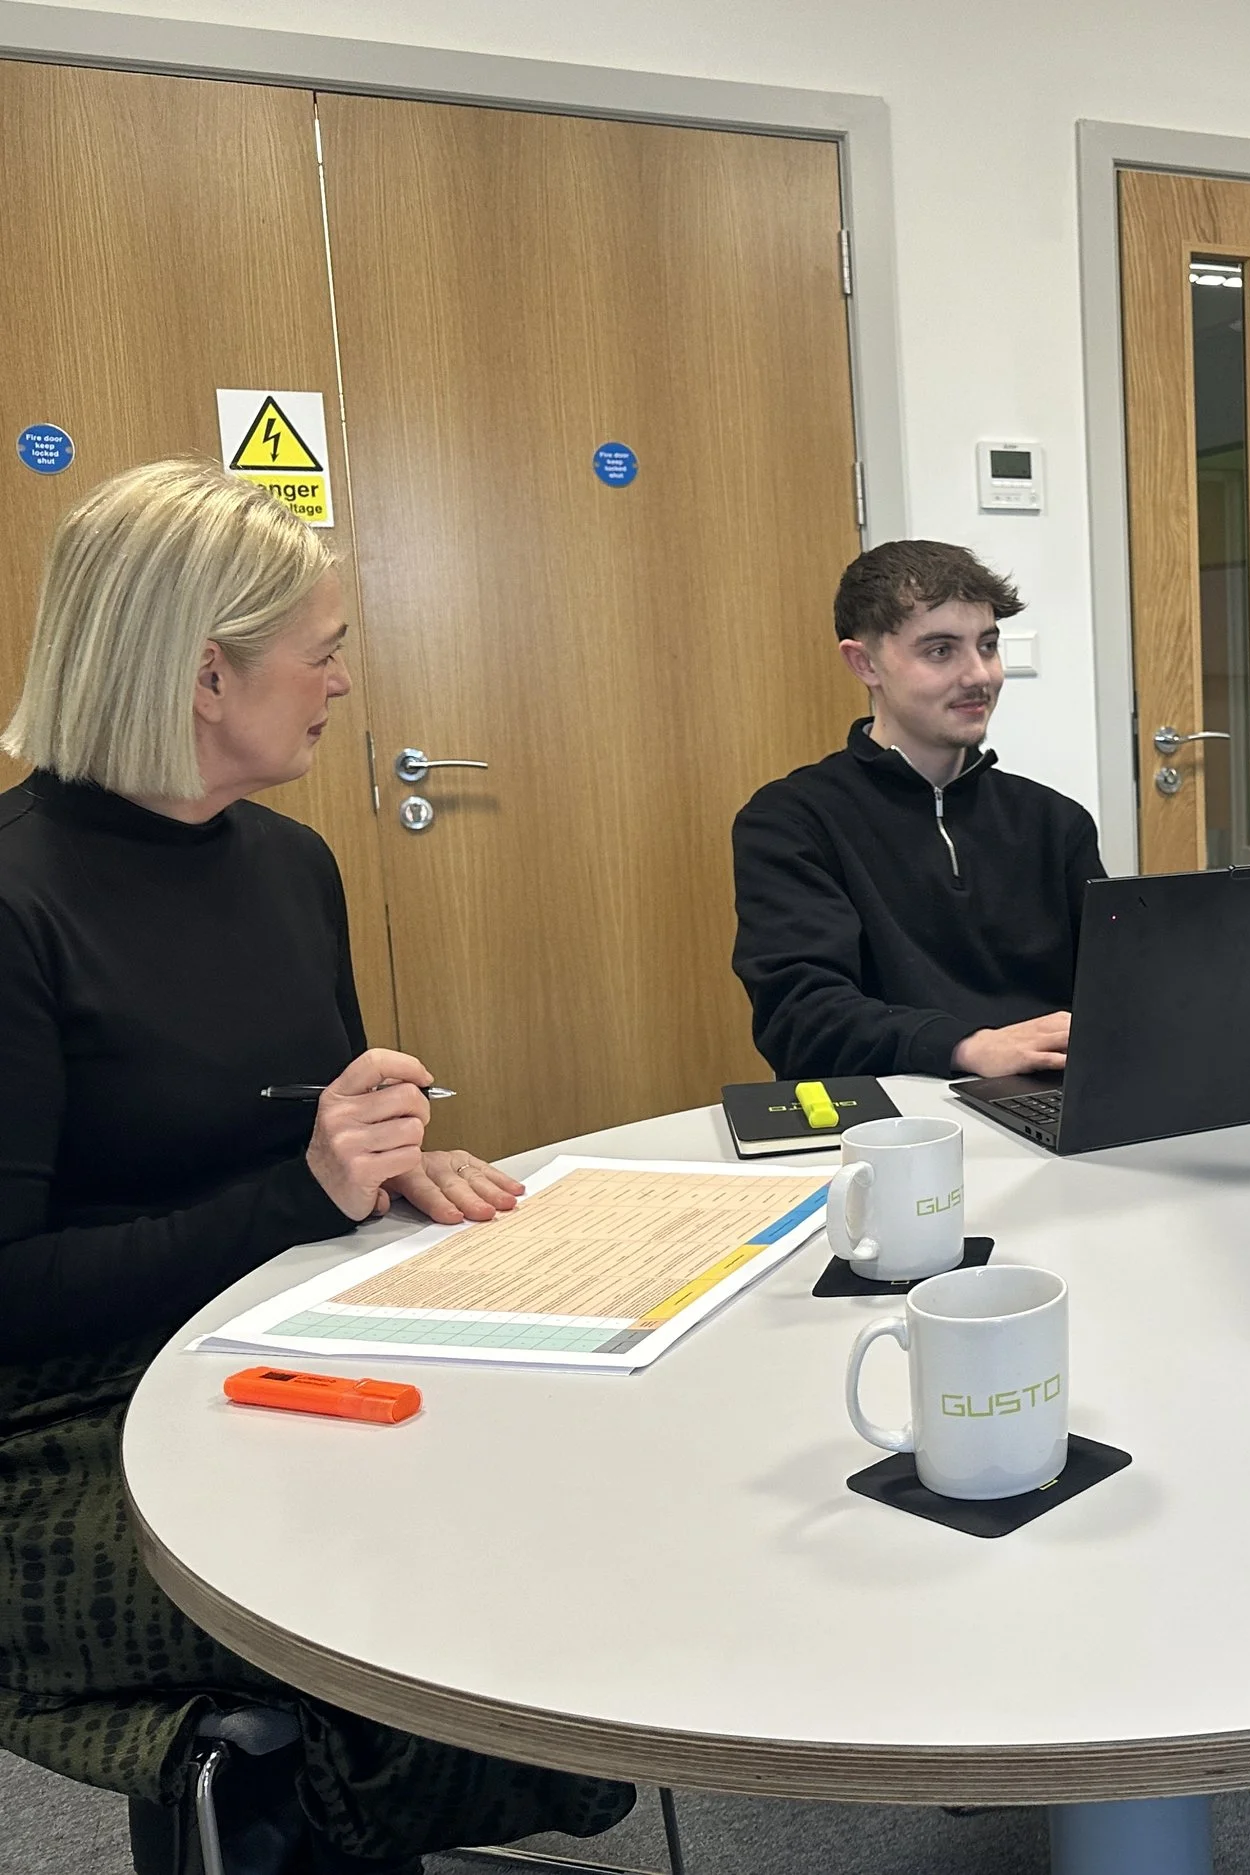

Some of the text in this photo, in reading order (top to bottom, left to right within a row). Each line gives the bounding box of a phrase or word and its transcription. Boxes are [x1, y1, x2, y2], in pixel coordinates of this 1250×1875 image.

[25, 433, 42, 441] Fire
[34, 442, 55, 450] keep
[31, 449, 59, 457] locked
[916, 1185, 964, 1216] GUS
[942, 1374, 1060, 1417] GUSTO
